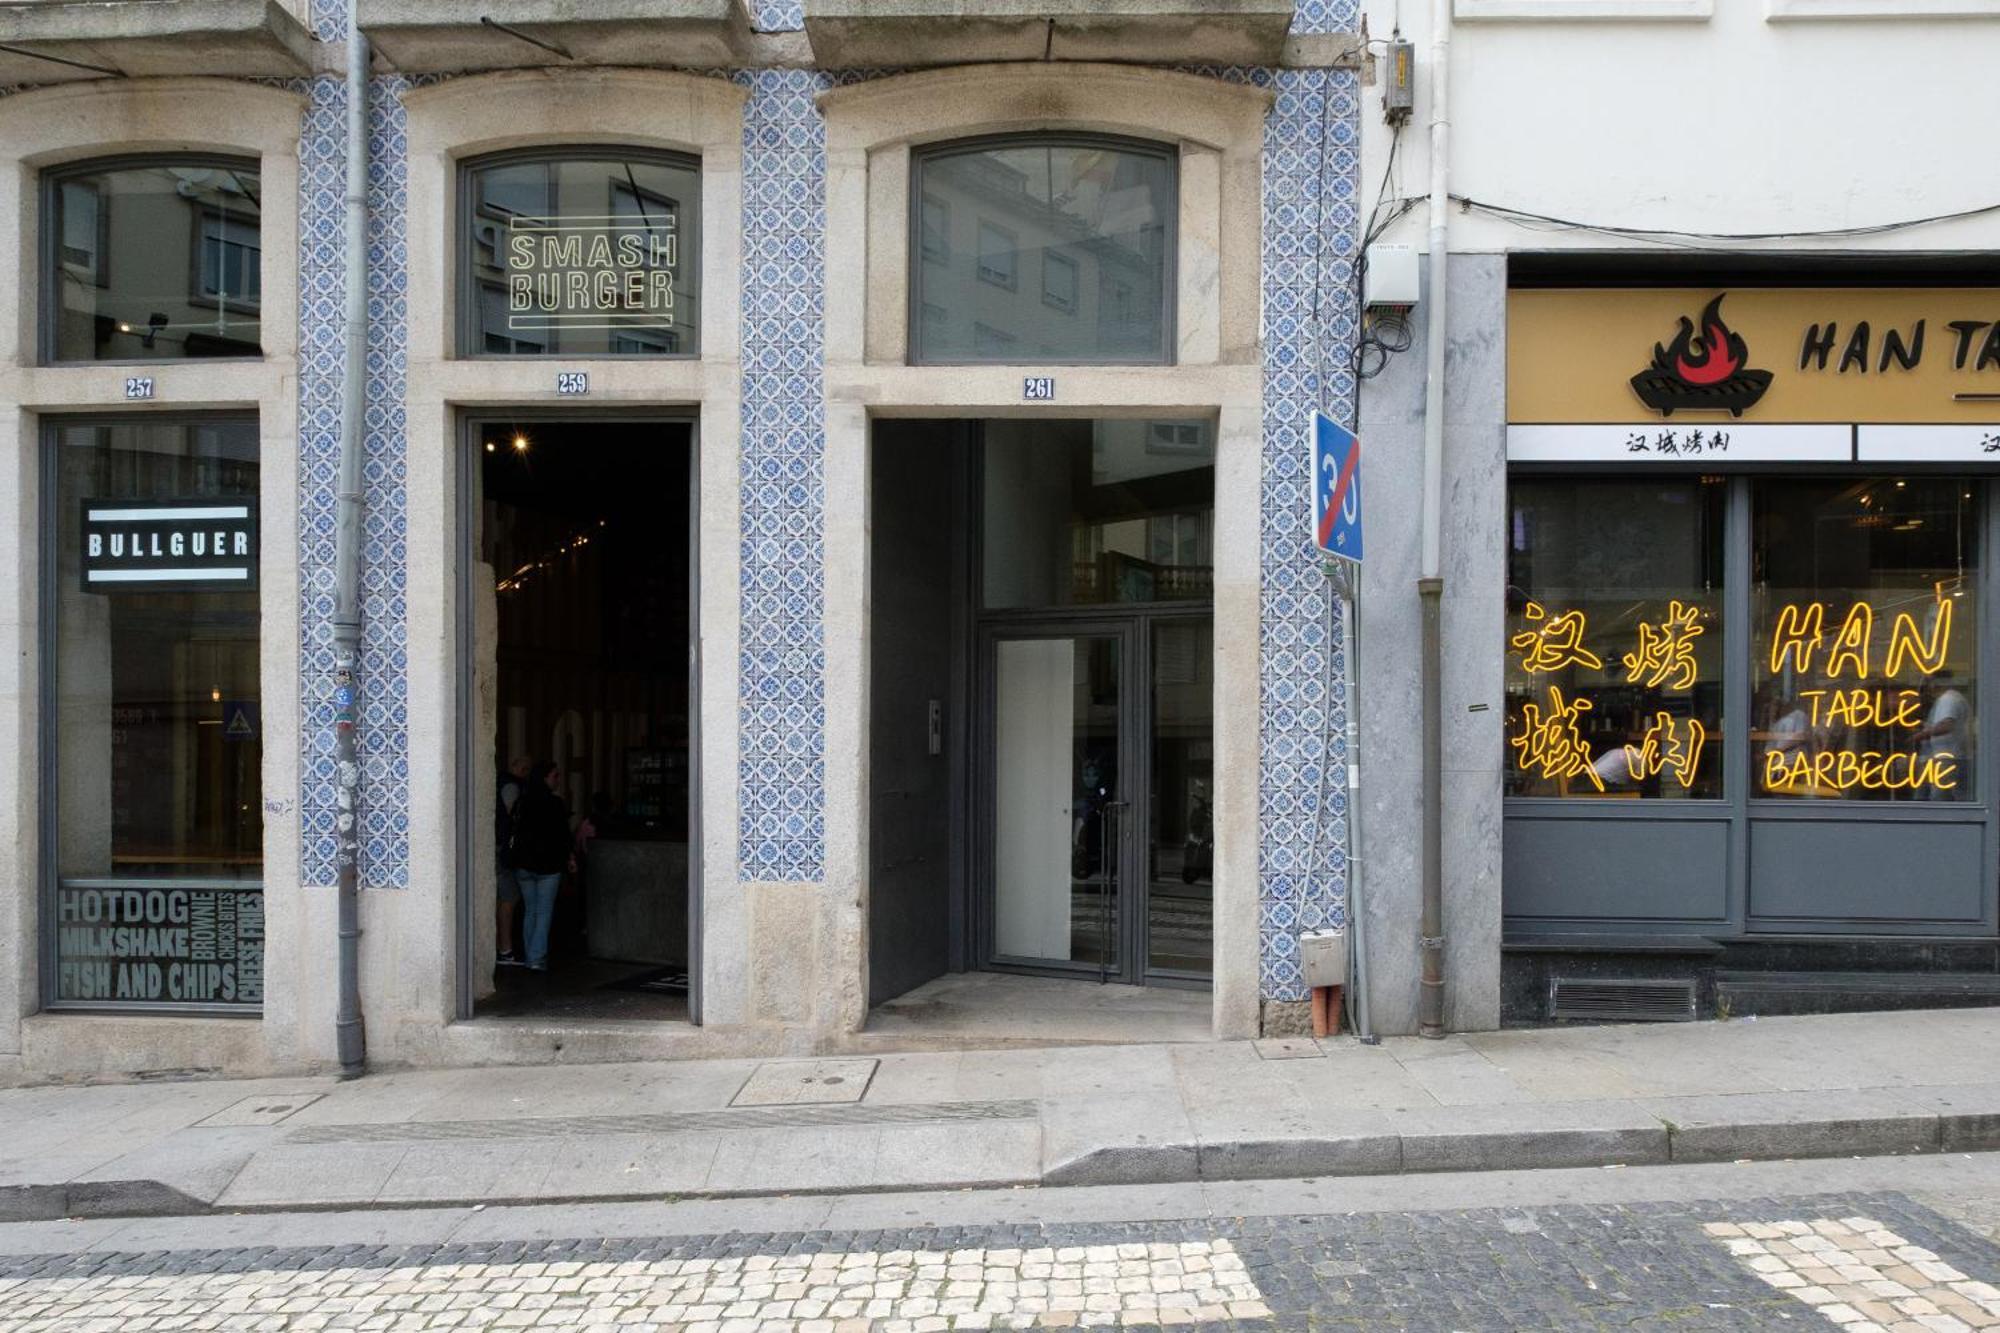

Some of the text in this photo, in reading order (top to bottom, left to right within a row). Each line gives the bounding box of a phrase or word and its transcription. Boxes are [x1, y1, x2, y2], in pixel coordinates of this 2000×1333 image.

[509, 234, 677, 270] SMASH
[510, 270, 673, 311] BURGER
[1799, 319, 1926, 373] HAN
[127, 379, 152, 397] 257
[559, 374, 586, 393] 259
[1026, 379, 1052, 397] 261
[1625, 429, 1730, 457] 汉城烤肉
[1322, 453, 1357, 526] 30
[88, 531, 248, 557] BULLGUER
[1771, 599, 1953, 679] HAN
[1799, 689, 1922, 728] TABLE
[1764, 751, 1958, 789] BARBECUE
[59, 889, 189, 924] HOTDOG
[59, 926, 189, 958] MILKSHAKE
[191, 891, 217, 961] BROWNIE
[217, 891, 237, 961] CHICKS BITES
[60, 961, 237, 1000] FISH AND CHIPS
[237, 940, 265, 1000] CHEESE
